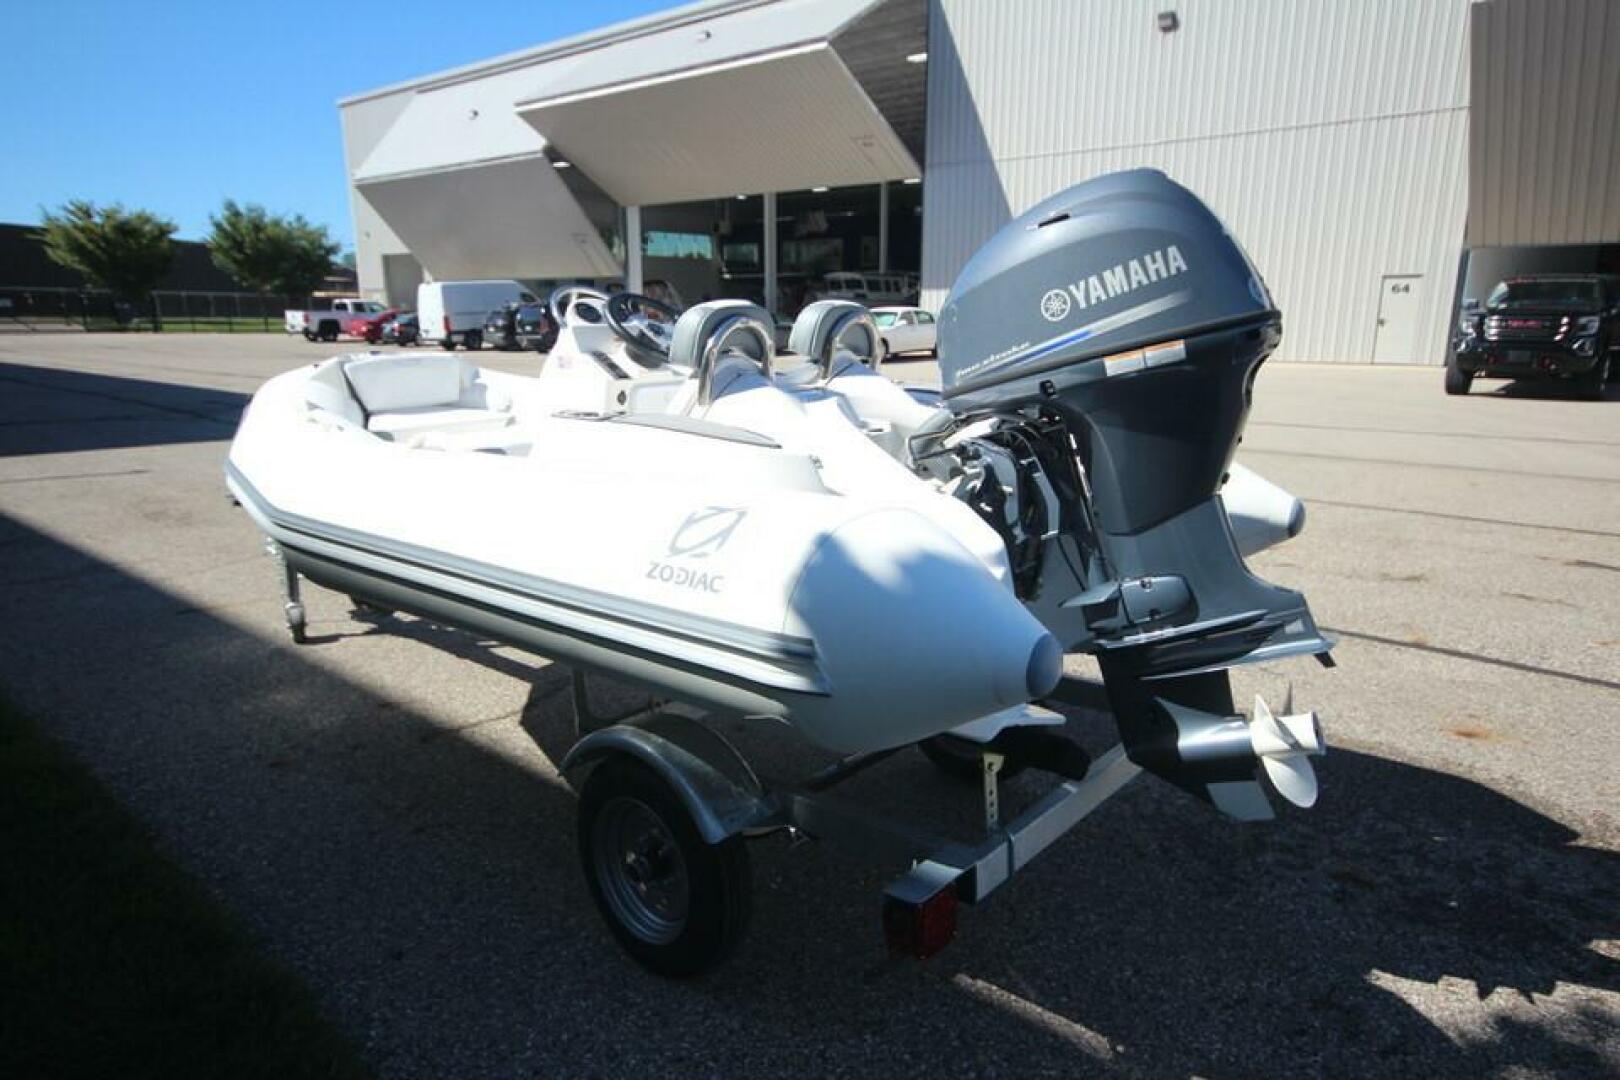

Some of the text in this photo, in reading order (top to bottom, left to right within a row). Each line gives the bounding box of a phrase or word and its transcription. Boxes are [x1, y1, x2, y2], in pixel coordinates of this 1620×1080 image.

[1069, 245, 1187, 309] YAMAHA
[1391, 283, 1410, 294] 64
[646, 561, 724, 593] ZODIAC
